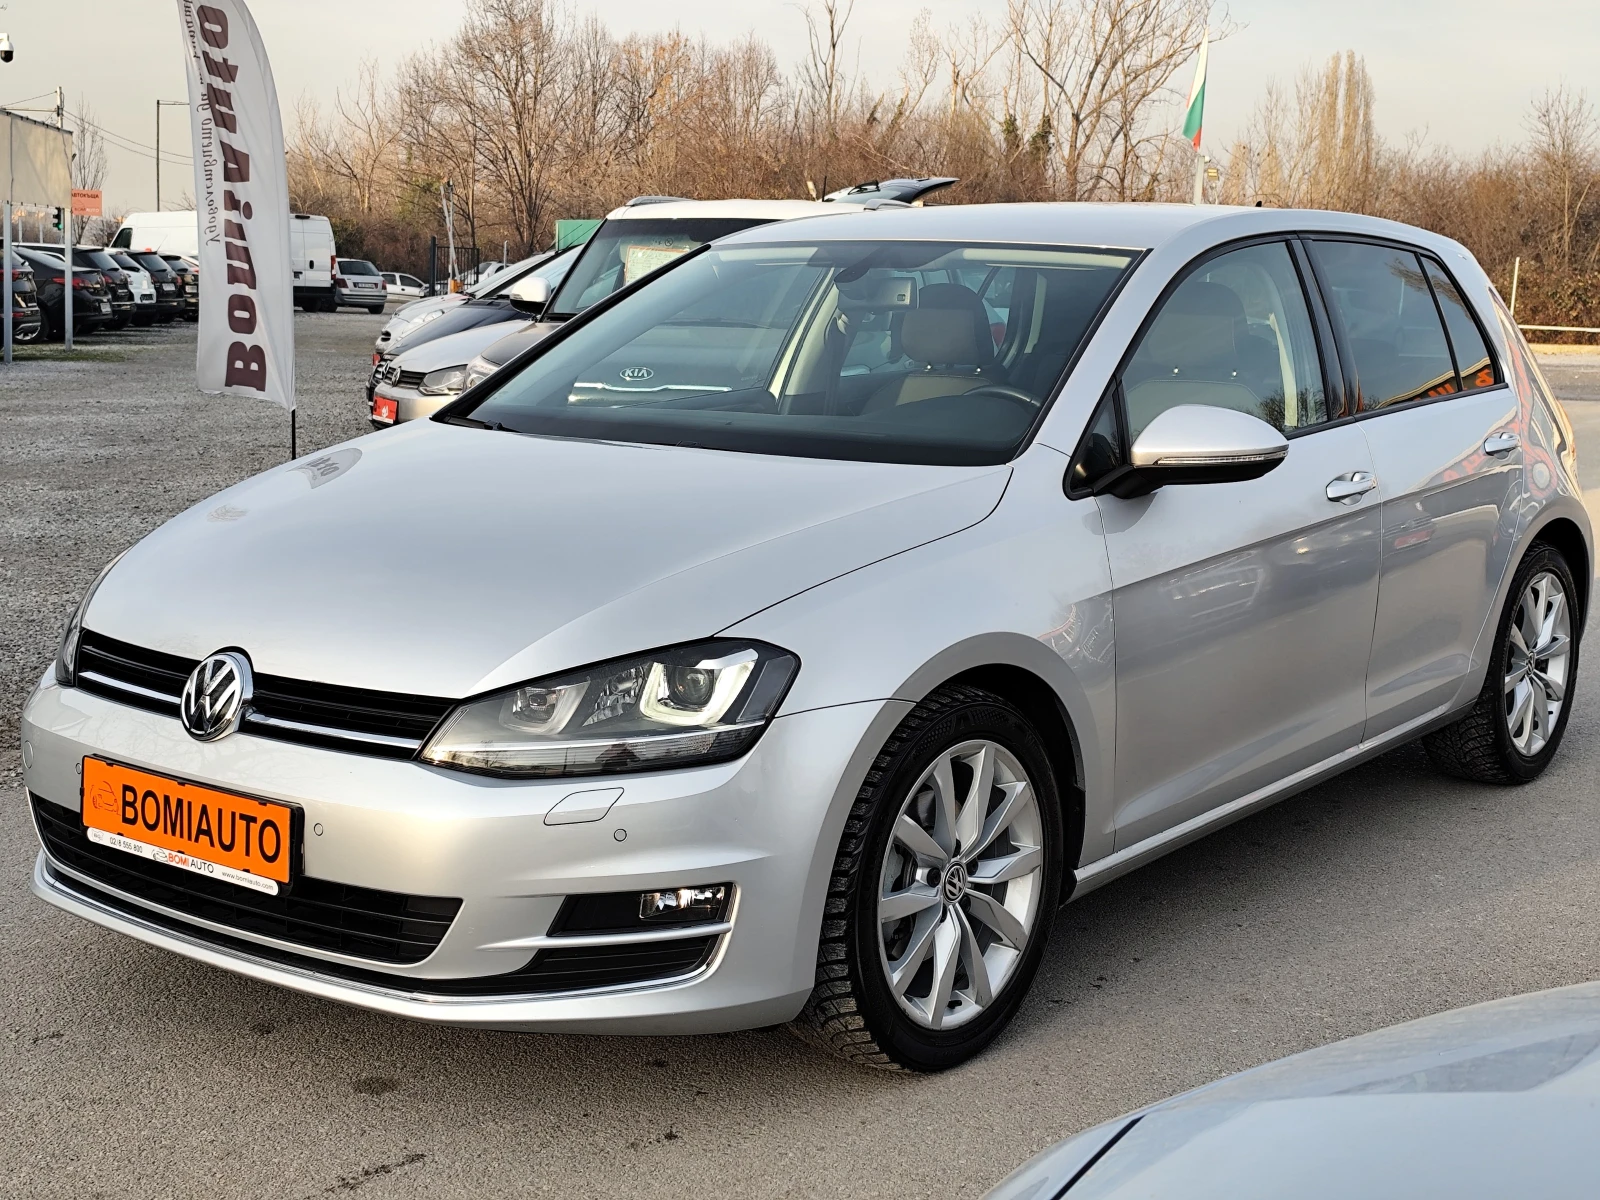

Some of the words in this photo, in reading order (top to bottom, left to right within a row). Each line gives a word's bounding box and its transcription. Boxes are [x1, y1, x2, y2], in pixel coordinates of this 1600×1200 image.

[623, 368, 648, 378] KIA
[121, 783, 281, 864] BOMIAUTO
[168, 852, 189, 867] BOMI
[190, 859, 215, 874] AUTO
[221, 870, 274, 891] www.bomiauto.com
